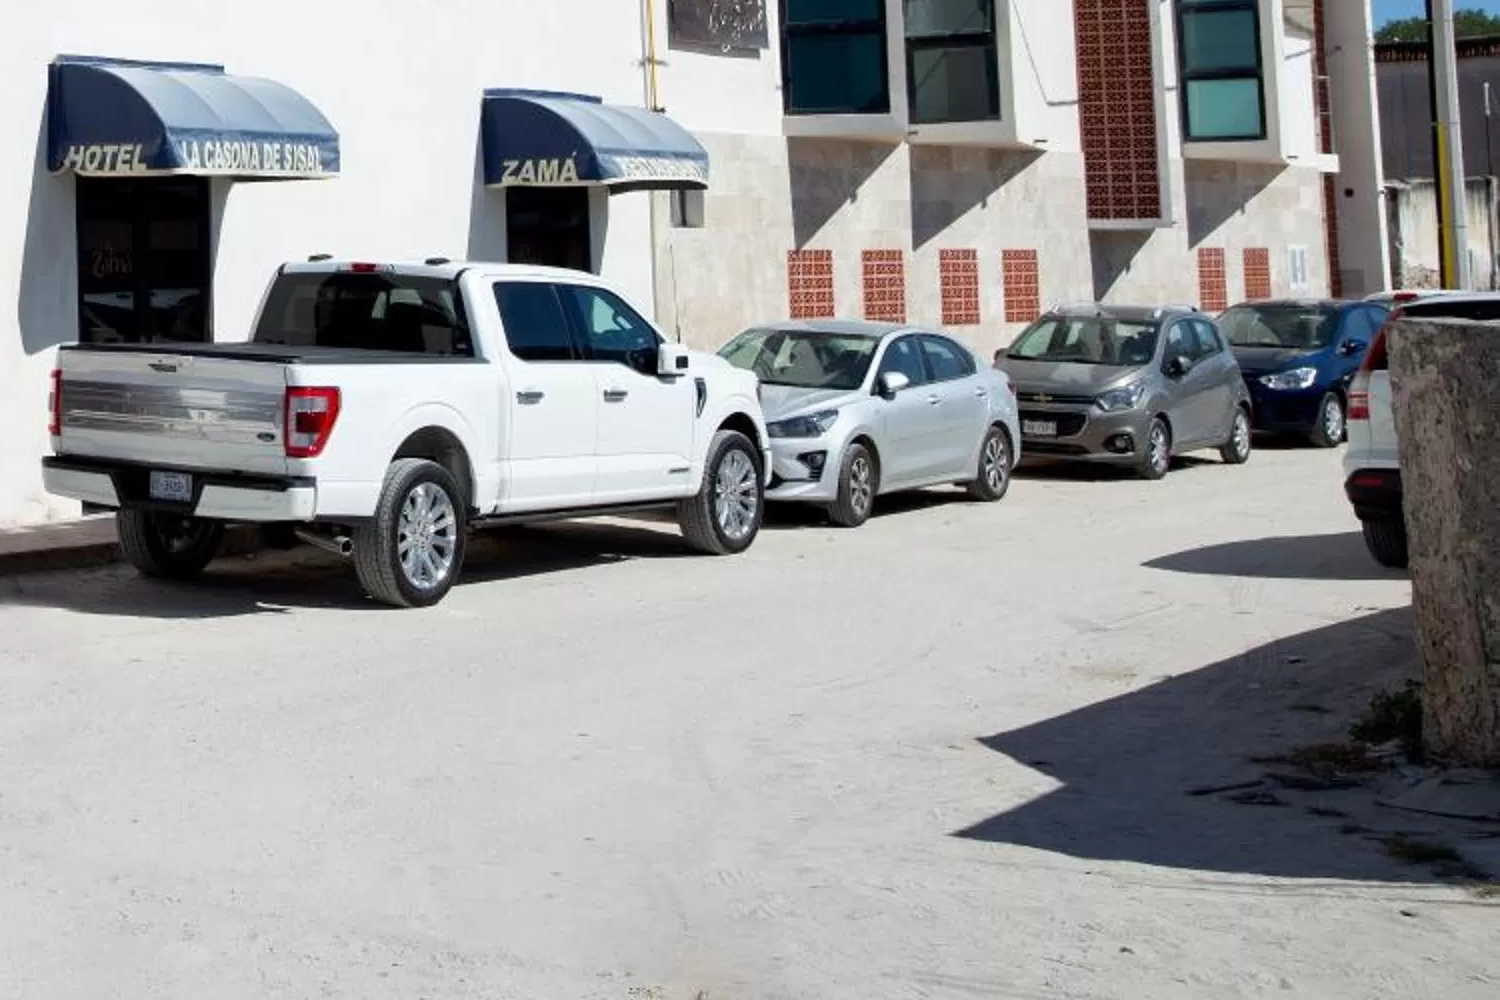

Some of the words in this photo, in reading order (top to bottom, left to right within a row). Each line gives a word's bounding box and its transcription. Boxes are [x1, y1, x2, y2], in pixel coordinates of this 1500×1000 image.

[63, 143, 148, 172] HOTEL
[182, 140, 201, 169] LA
[204, 140, 260, 170] CASONA
[263, 142, 282, 171] DE
[283, 143, 323, 172] SISAL
[501, 151, 579, 185] ZAMÁ
